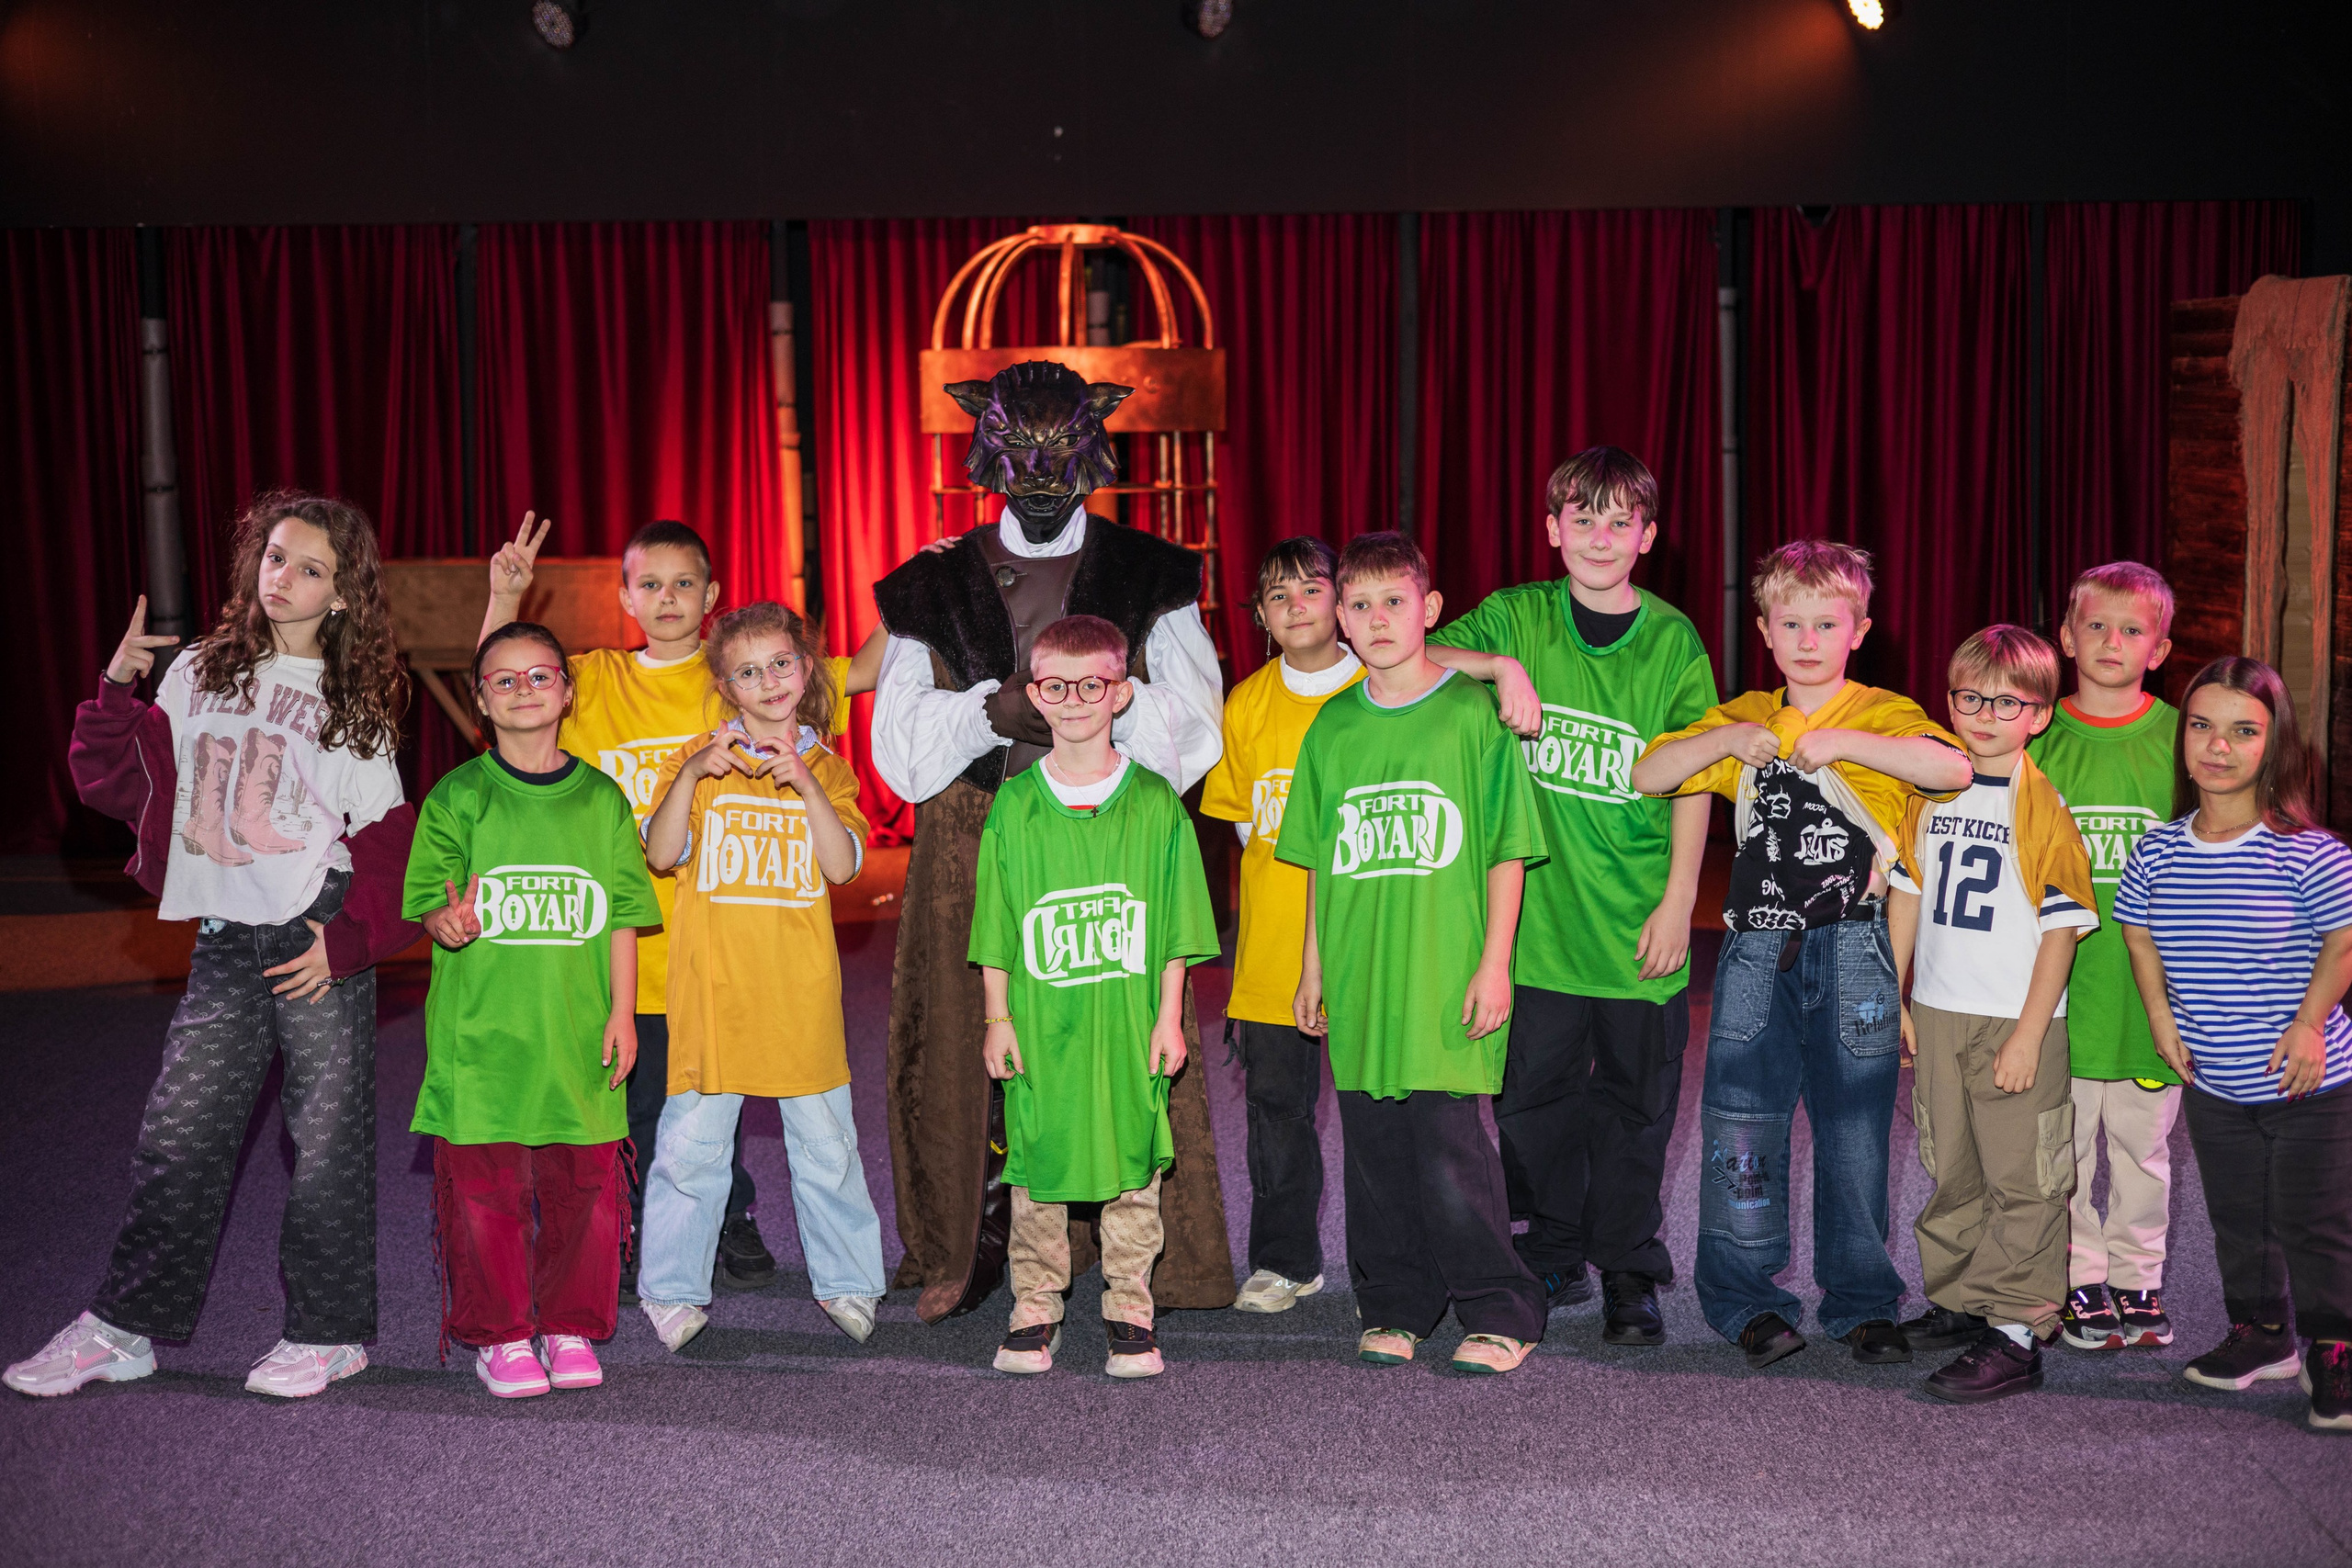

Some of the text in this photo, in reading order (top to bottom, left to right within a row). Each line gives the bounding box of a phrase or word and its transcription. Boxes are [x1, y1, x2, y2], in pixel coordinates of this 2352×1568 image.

[266, 682, 332, 753] WES
[1547, 716, 1617, 745] FORT
[1360, 794, 1421, 817] FORT
[725, 808, 800, 834] FORT
[1331, 794, 1464, 875] BOYARD
[1926, 816, 1963, 835] EST
[2075, 817, 2141, 831] FORT
[506, 875, 574, 892] FORT
[1933, 840, 2003, 932] 12
[474, 876, 608, 940] BOYARD
